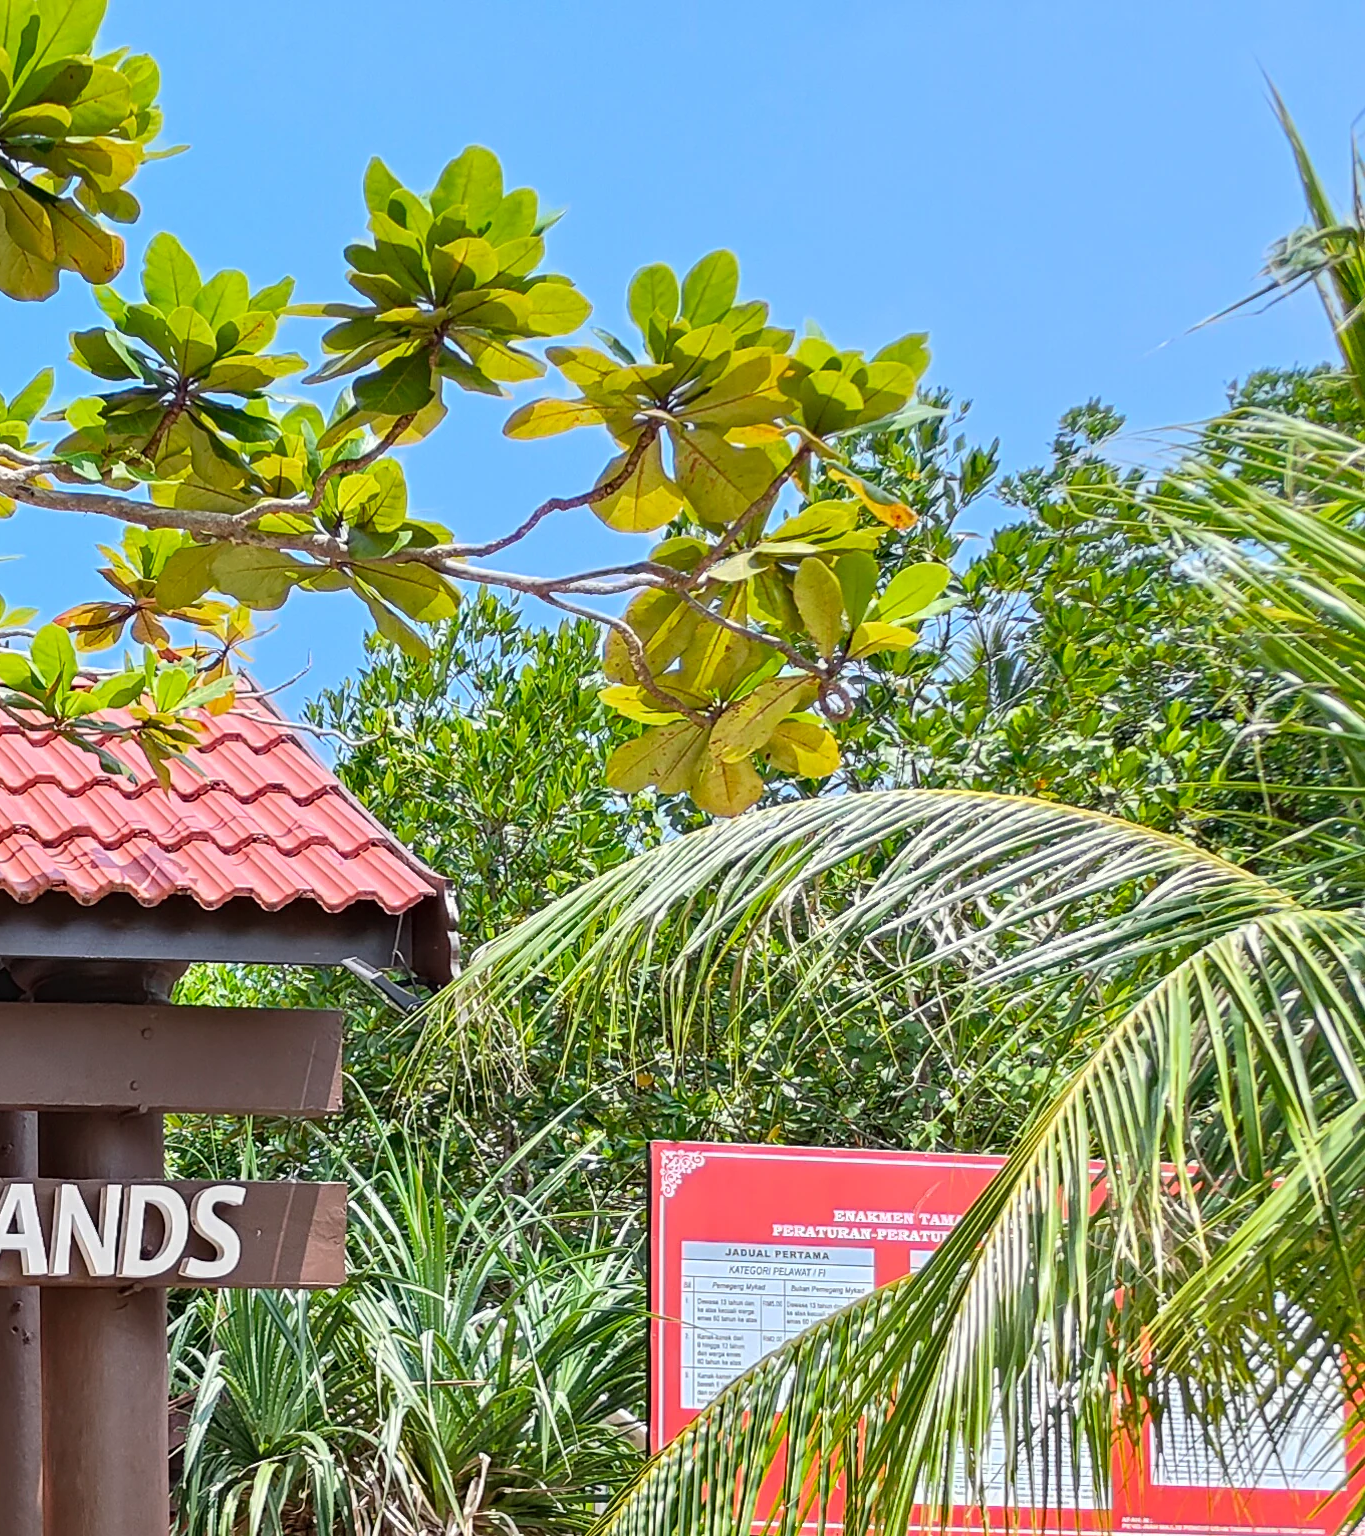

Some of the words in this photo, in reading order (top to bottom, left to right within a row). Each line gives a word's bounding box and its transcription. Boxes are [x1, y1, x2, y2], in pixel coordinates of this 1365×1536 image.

[833, 1210, 914, 1224] ENAKMEN
[725, 1248, 771, 1258] JADUAL
[775, 1250, 830, 1260] PERTAMA
[728, 1266, 771, 1275] KATEGORI
[773, 1267, 811, 1276] PELAWAT
